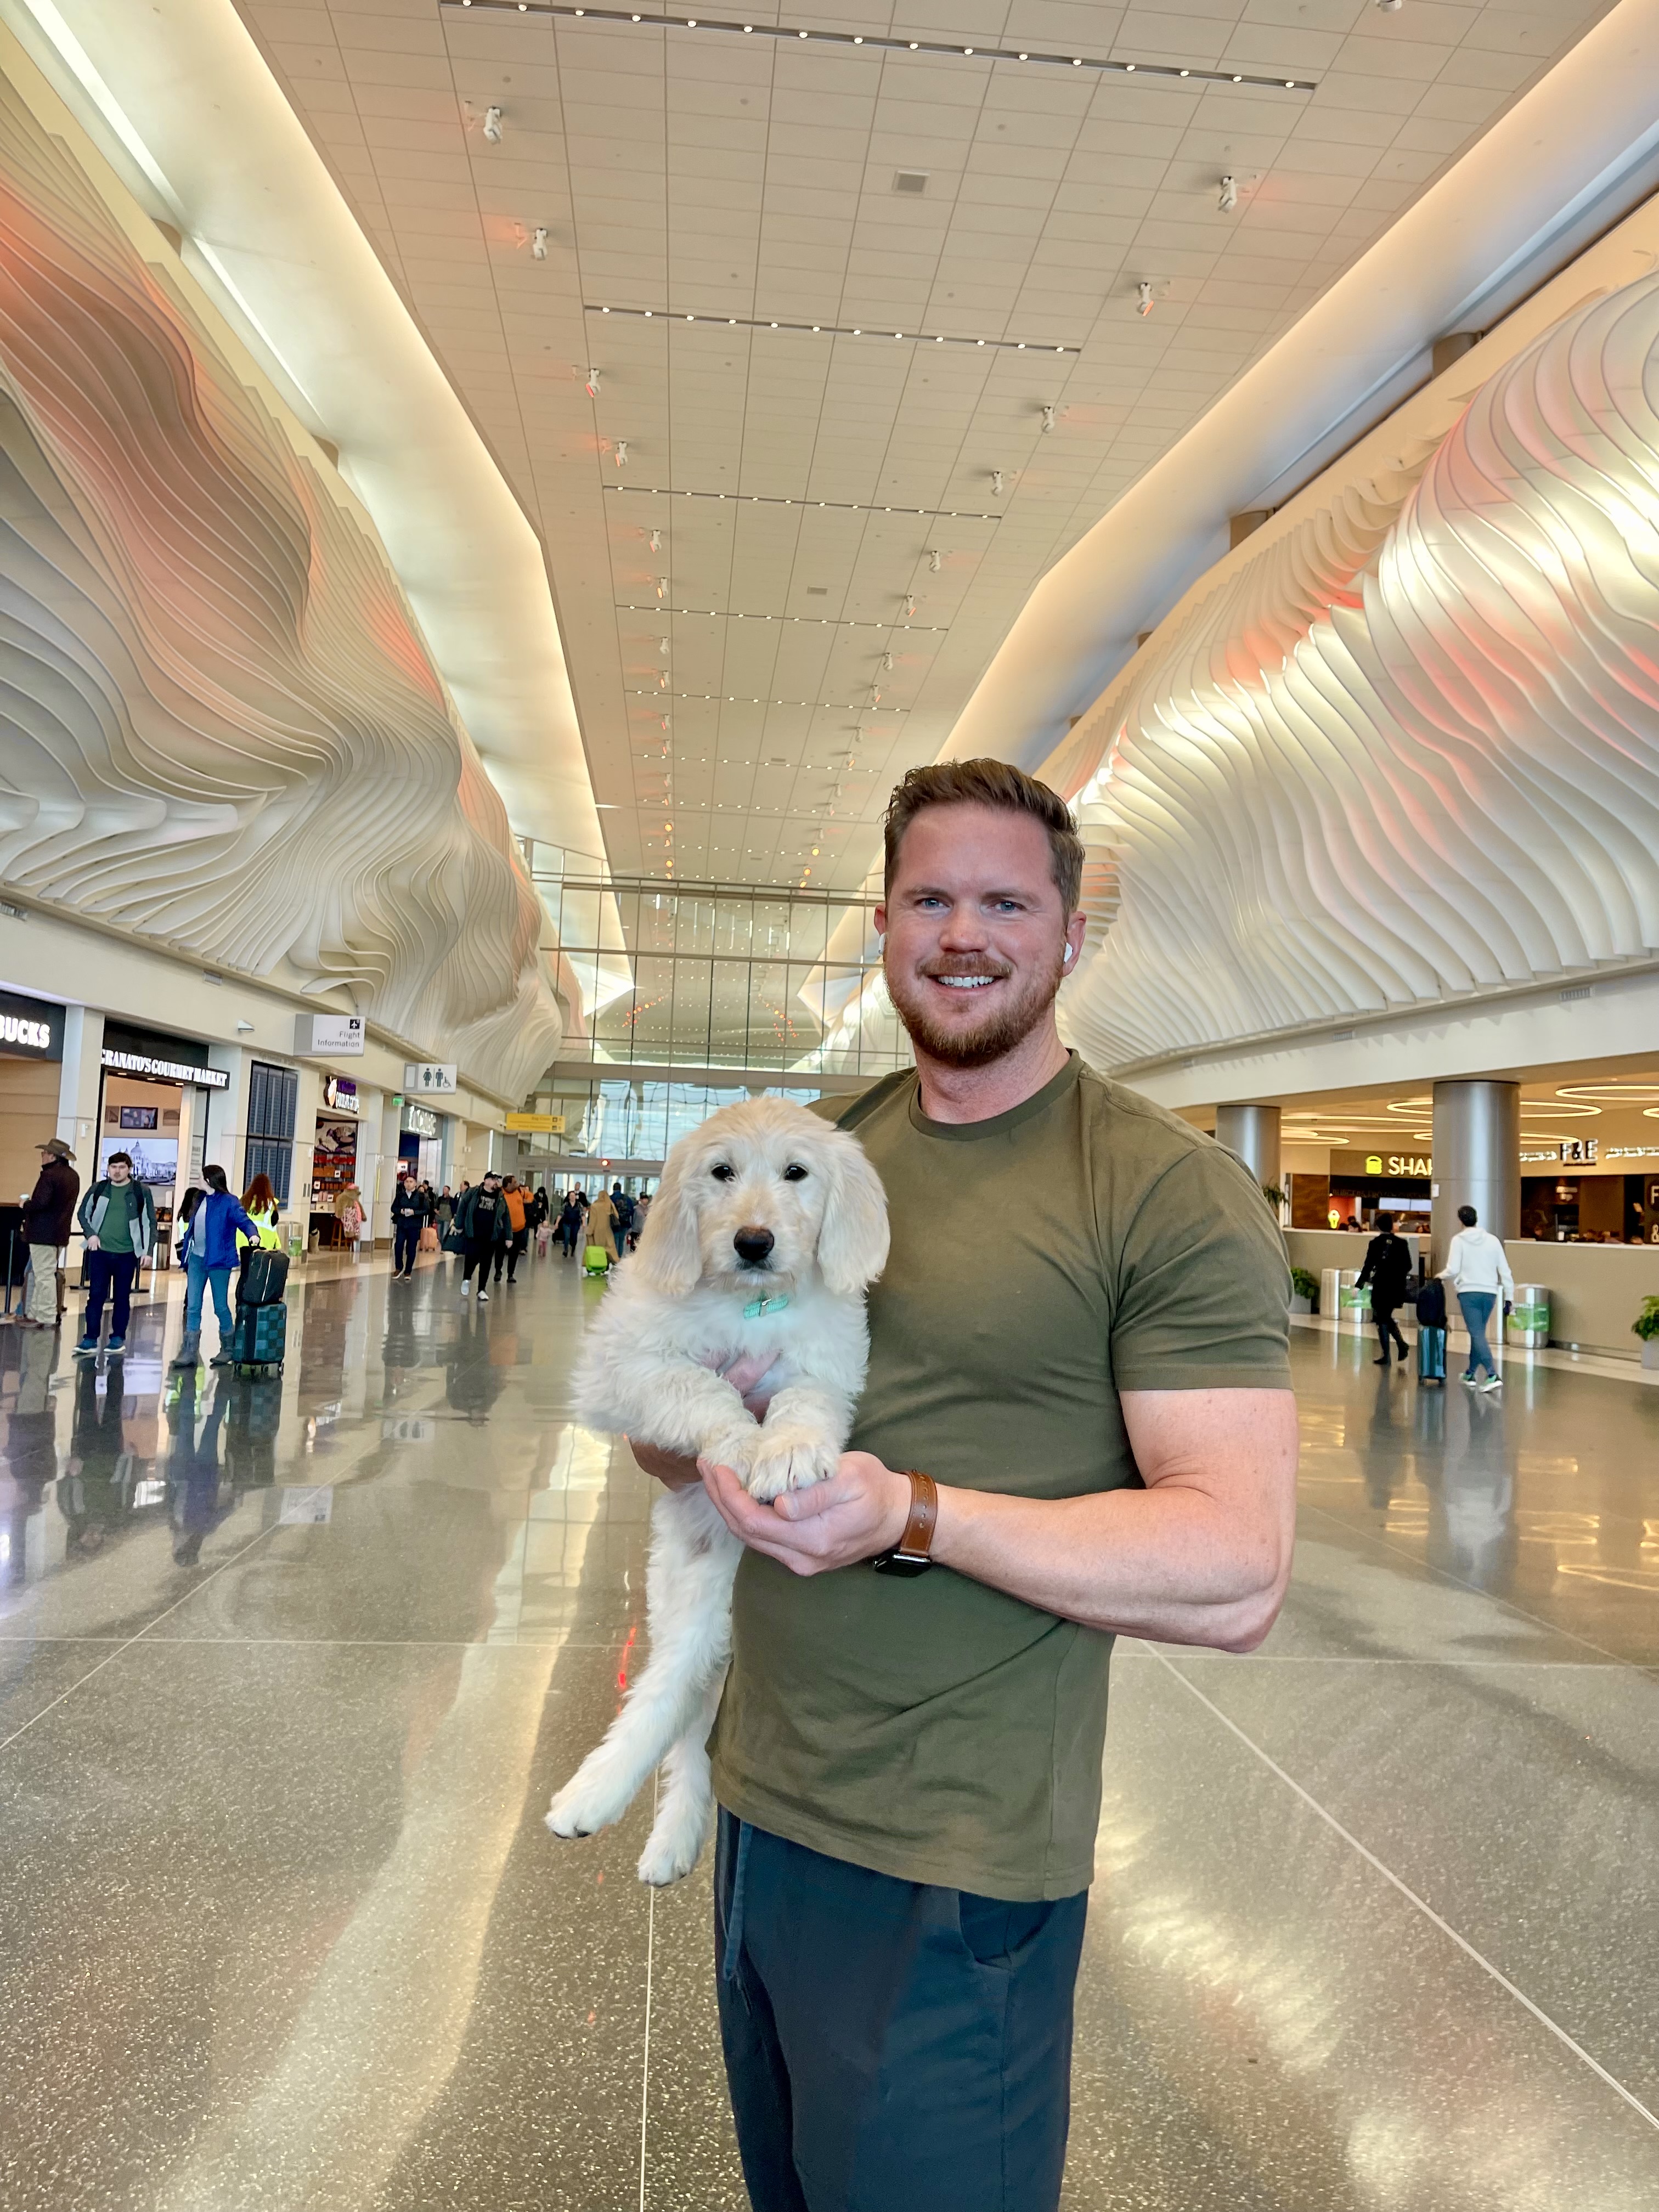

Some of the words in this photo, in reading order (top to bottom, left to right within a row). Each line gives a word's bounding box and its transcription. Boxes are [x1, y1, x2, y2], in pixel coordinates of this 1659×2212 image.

[318, 1039, 359, 1047] Information
[339, 1031, 360, 1040] Flight
[151, 1059, 194, 1081] GOURMET
[193, 1068, 228, 1087] MARKET
[1561, 1138, 1598, 1163] F&E
